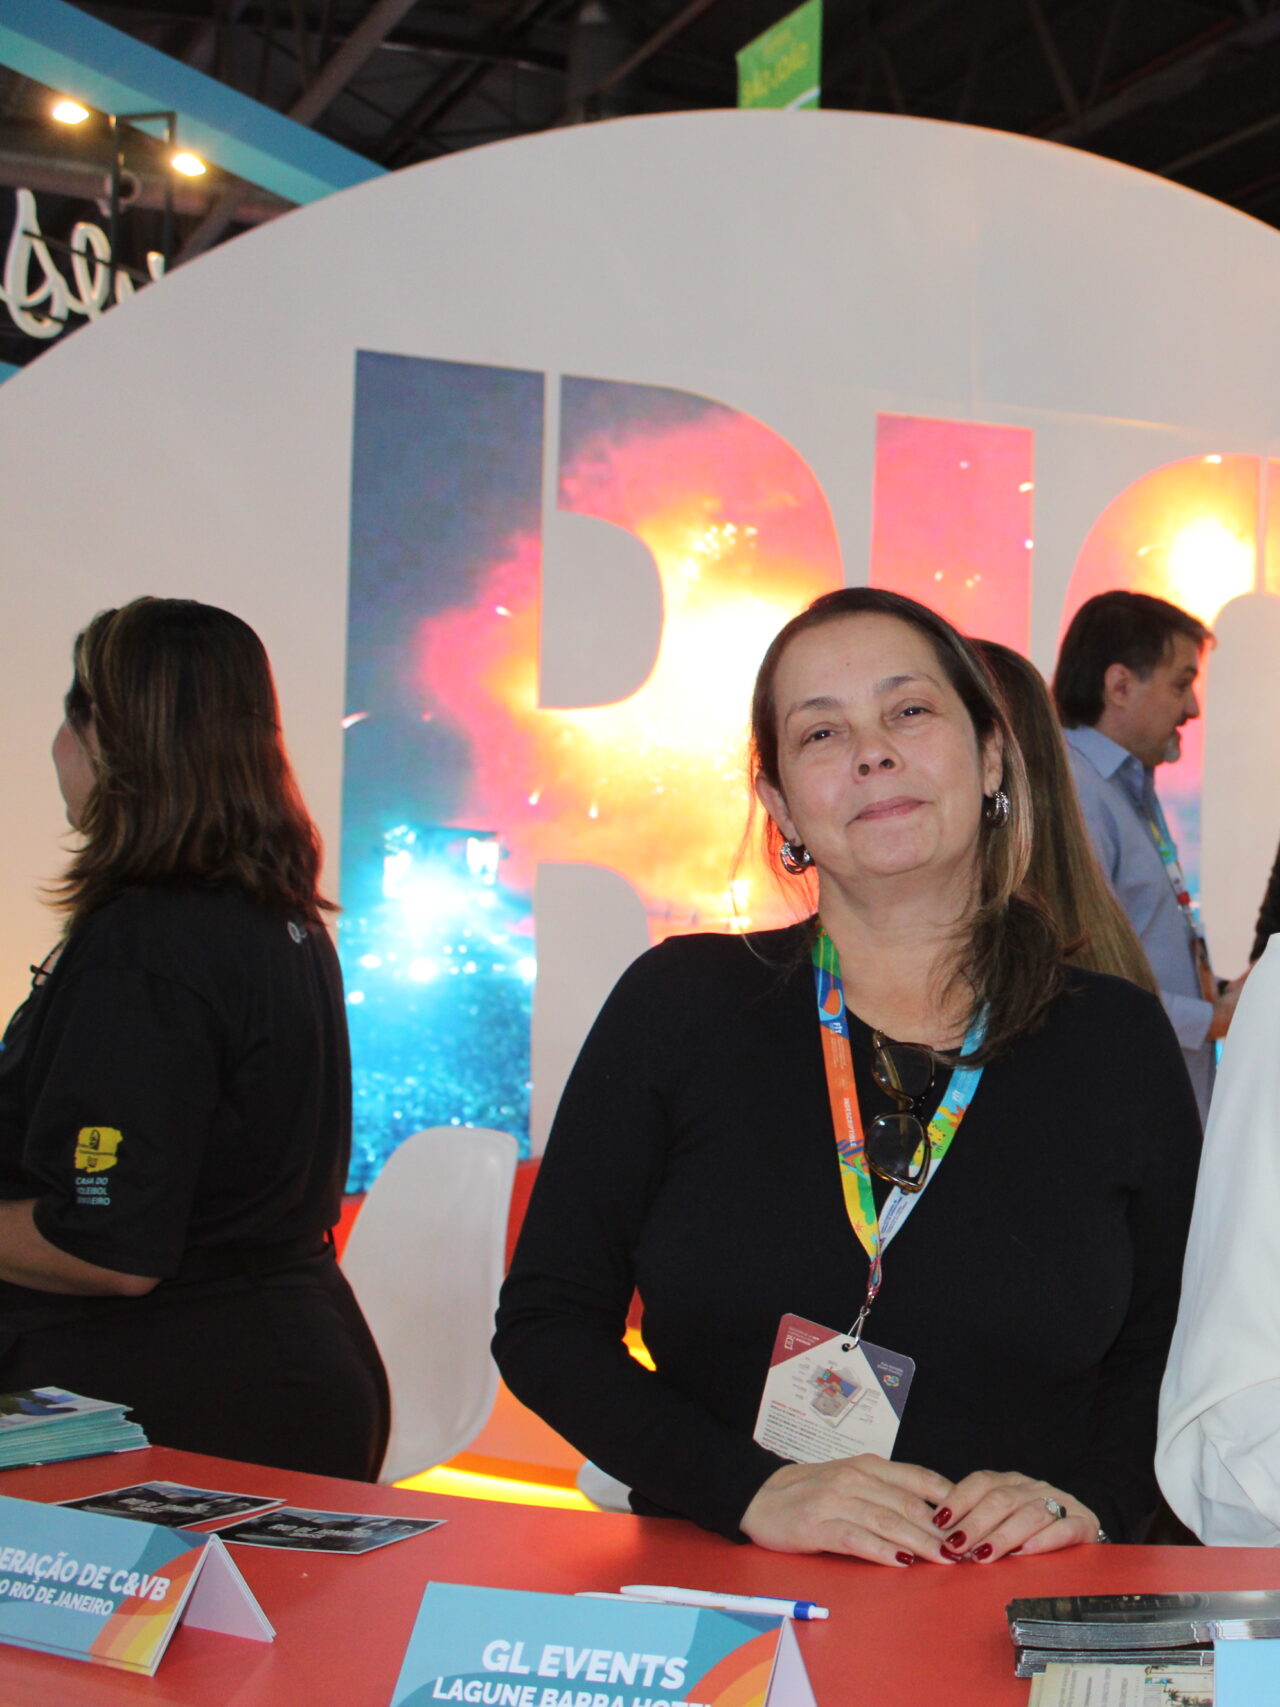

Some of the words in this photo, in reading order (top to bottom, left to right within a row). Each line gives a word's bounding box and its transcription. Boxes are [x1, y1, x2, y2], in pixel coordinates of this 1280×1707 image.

[0, 1547, 79, 1583] ERAÇÃO
[77, 1562, 111, 1590] DE
[109, 1569, 171, 1602] C&VB
[9, 1581, 36, 1600] RIO
[34, 1586, 57, 1604] DE
[54, 1590, 114, 1617] JANEIRO
[481, 1638, 531, 1675] GL
[537, 1643, 689, 1690] EVENTS
[432, 1676, 538, 1707] LAGUNE
